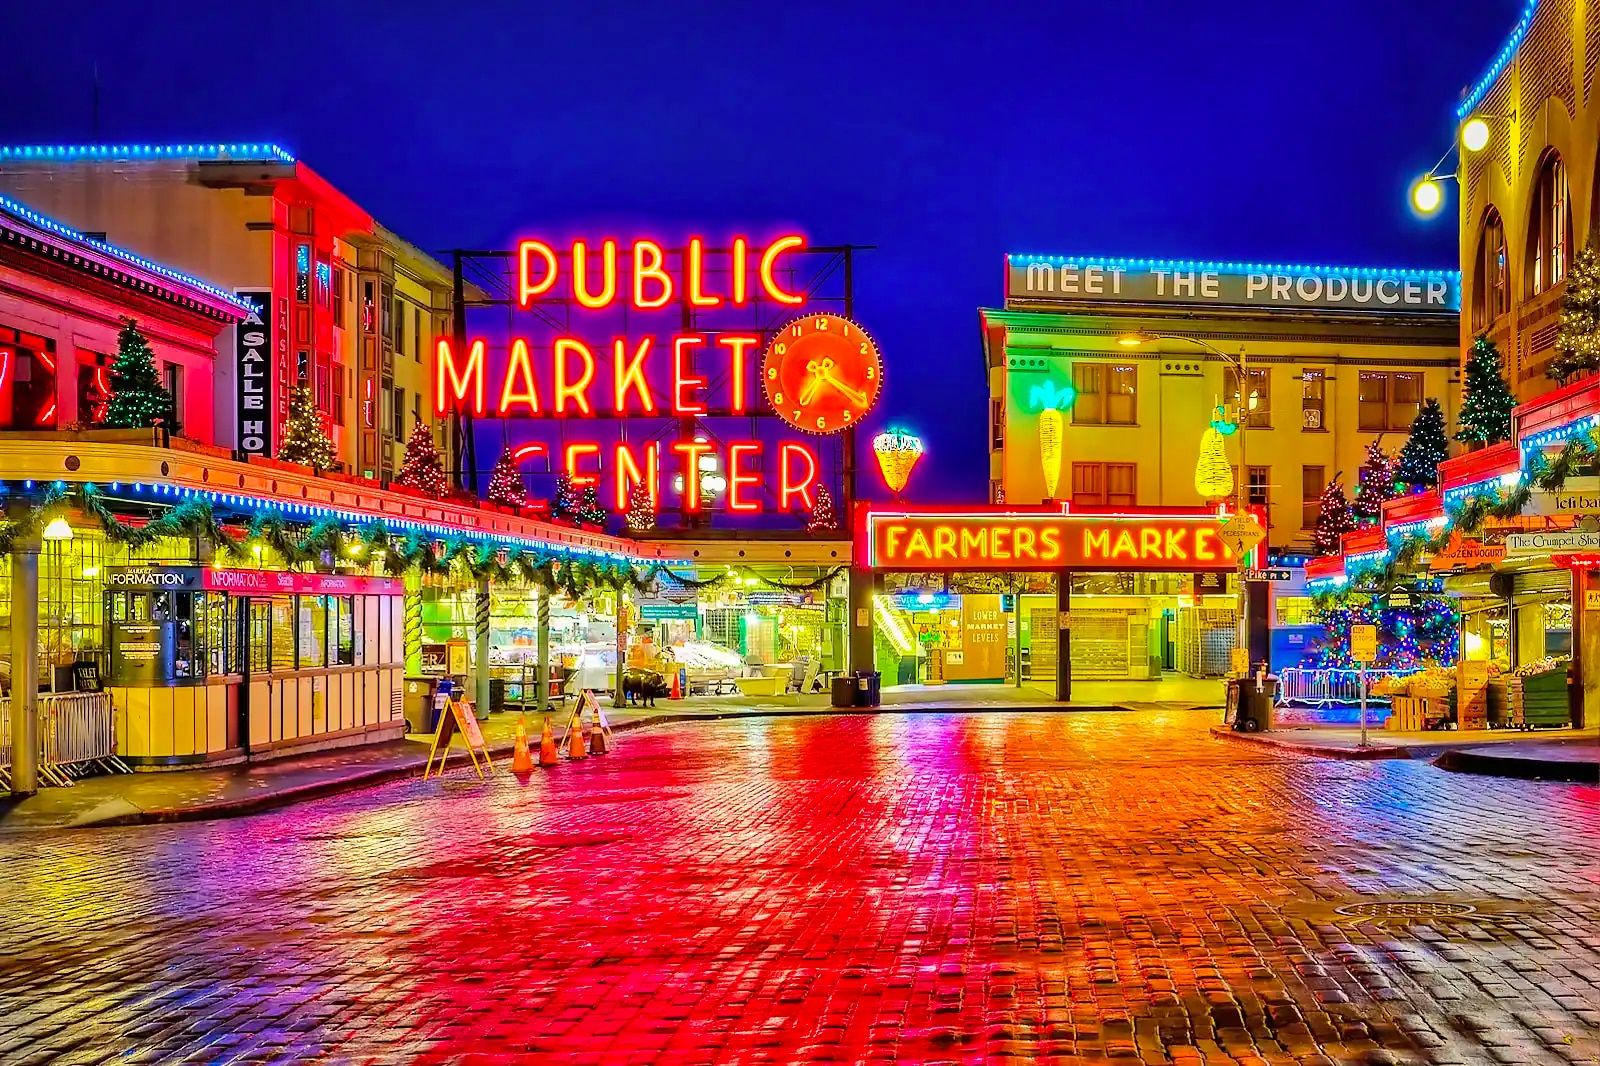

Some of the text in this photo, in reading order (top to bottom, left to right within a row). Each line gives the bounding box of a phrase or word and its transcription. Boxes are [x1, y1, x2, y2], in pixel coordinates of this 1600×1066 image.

[517, 236, 806, 309] PUBLIC
[1026, 262, 1448, 306] MEET THE PRODUCER
[815, 318, 828, 330] 12
[792, 325, 802, 336] 11
[844, 325, 849, 336] 1
[774, 343, 786, 354] 10
[860, 342, 868, 354] 2
[241, 331, 265, 409] SALLE
[435, 335, 759, 417] MARKET
[767, 367, 777, 379] 9
[866, 366, 875, 379] 3
[279, 339, 287, 414] SALLE
[774, 392, 783, 405] 8
[793, 410, 801, 421] 7
[843, 410, 852, 421] 5
[816, 416, 826, 429] 6
[241, 421, 264, 456] HO
[886, 525, 1234, 561] FARMERS MARKE
[1511, 536, 1530, 548] The
[1533, 535, 1574, 550] Crumpet
[1475, 549, 1503, 557] YOGURT
[211, 573, 258, 588] INFORMATION
[1249, 570, 1267, 580] Pike
[973, 611, 997, 620] LOWER
[972, 633, 998, 643] LEVELS
